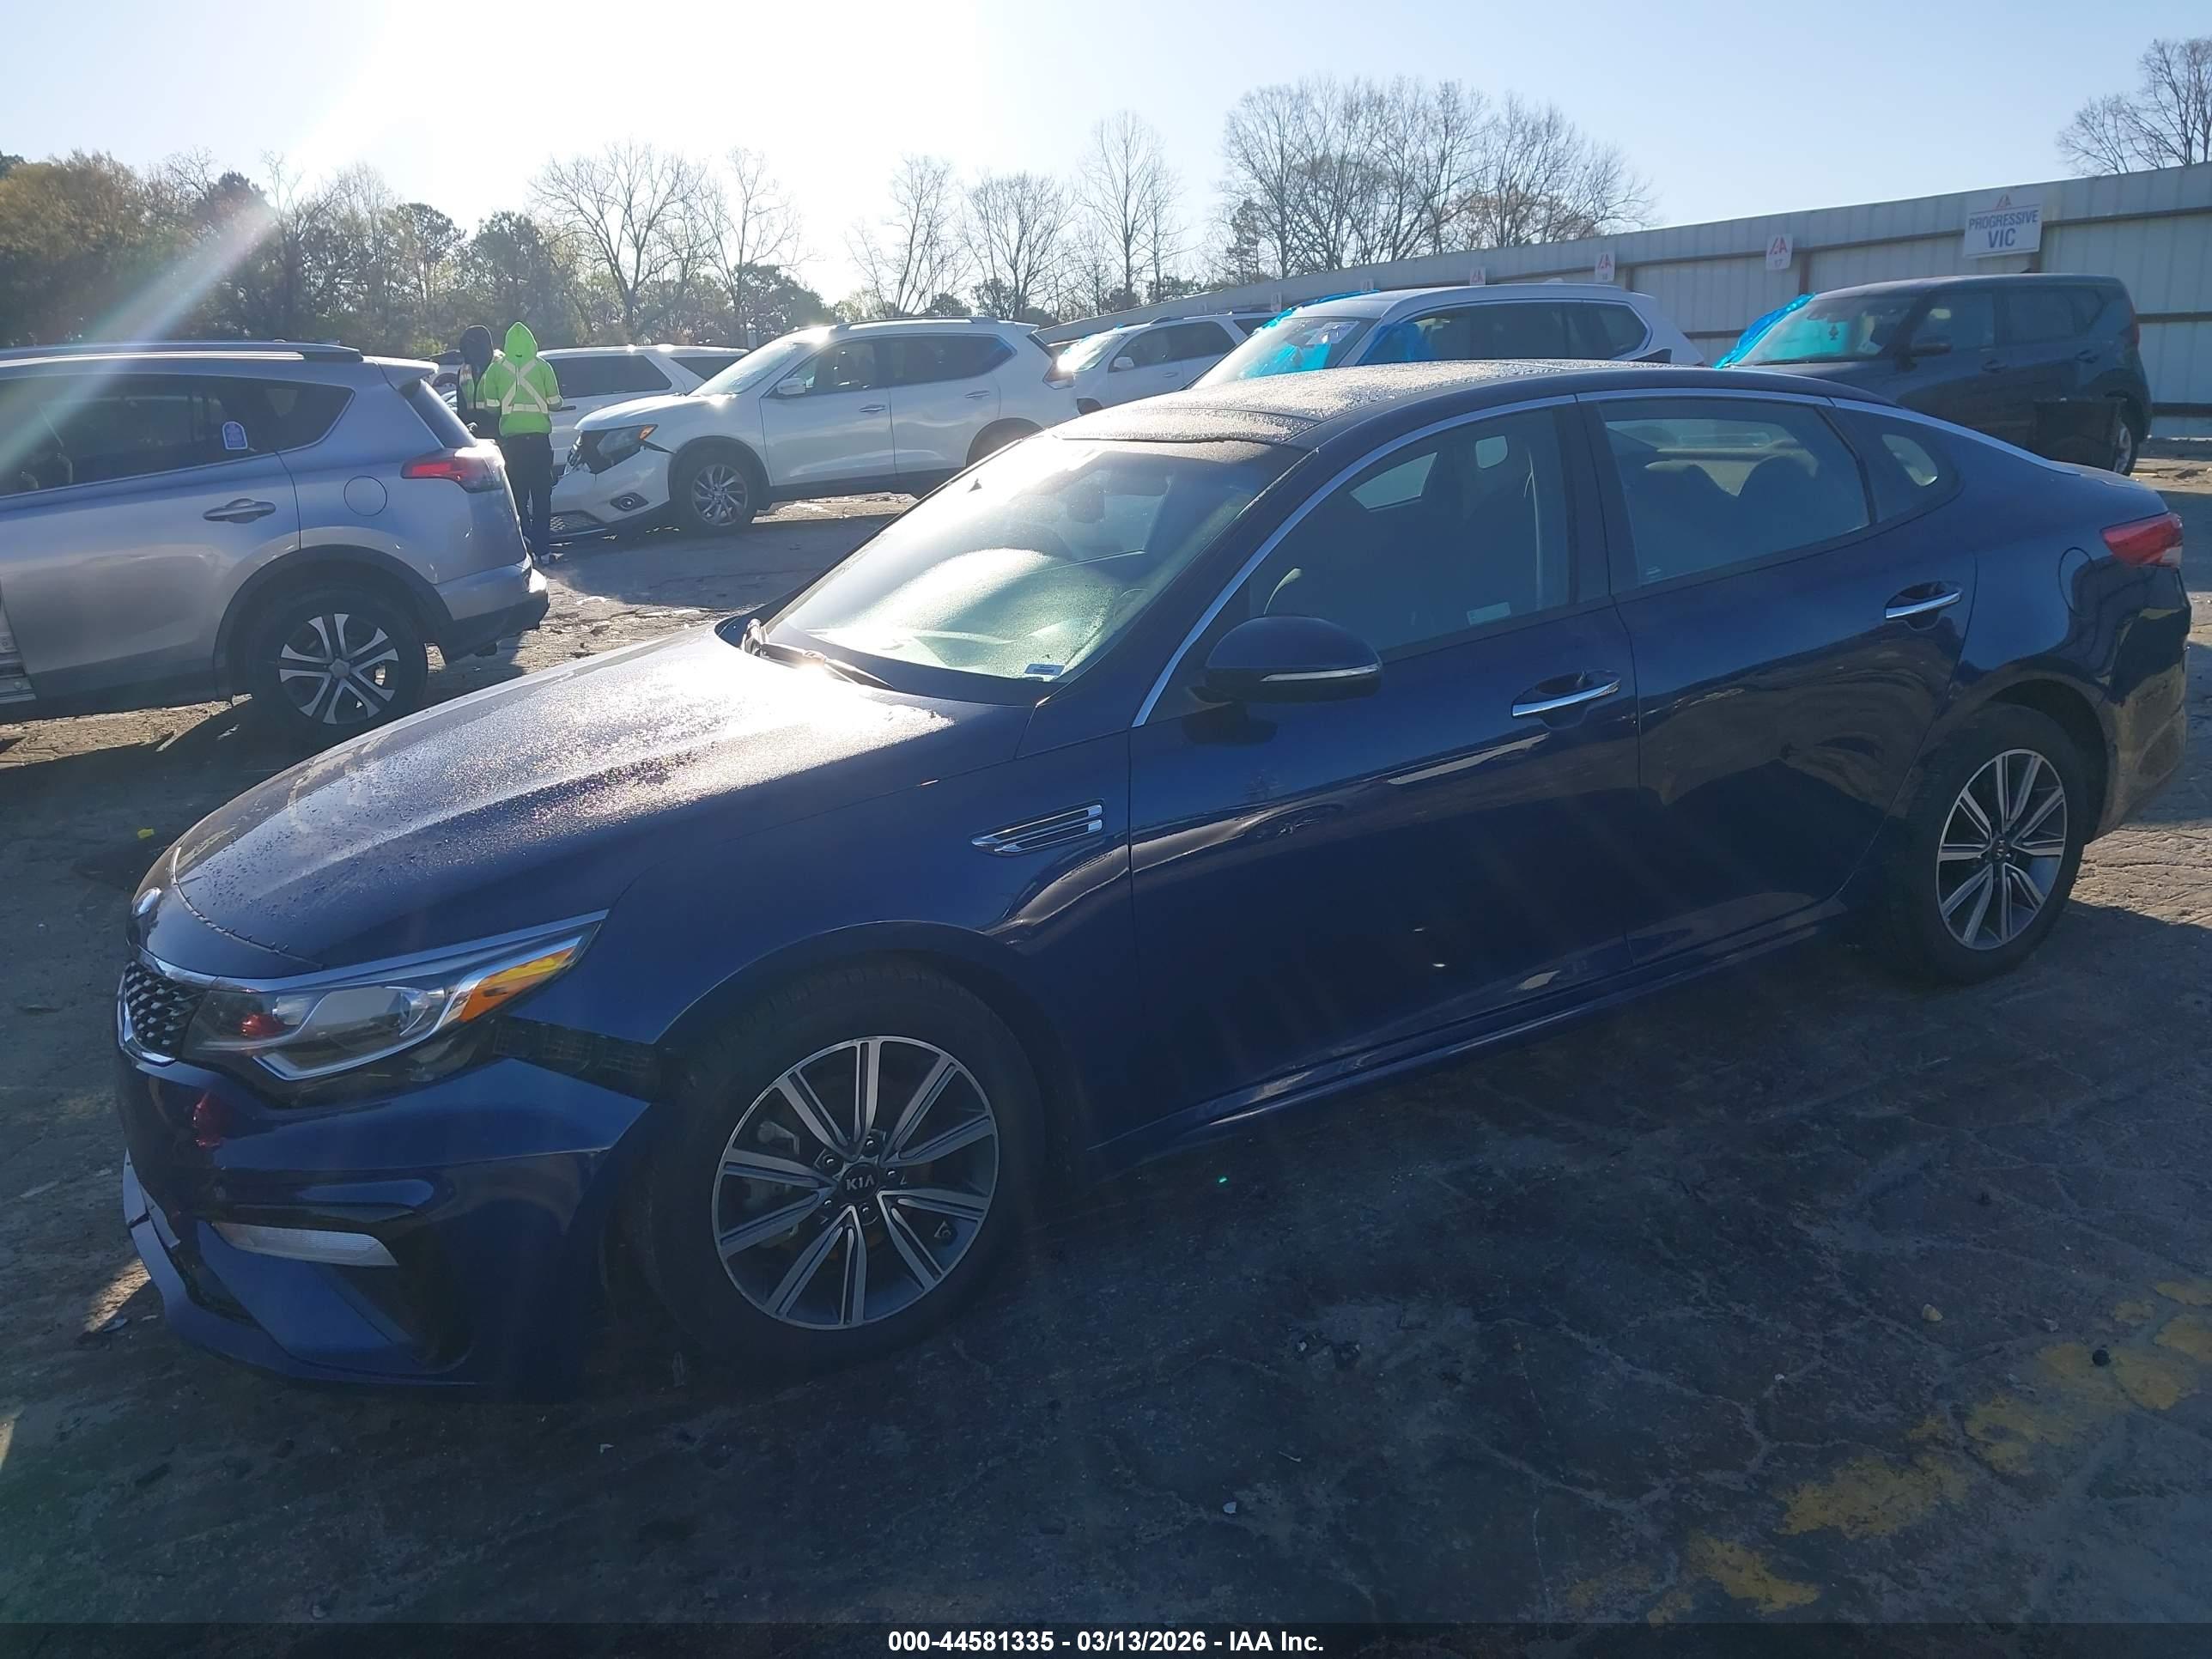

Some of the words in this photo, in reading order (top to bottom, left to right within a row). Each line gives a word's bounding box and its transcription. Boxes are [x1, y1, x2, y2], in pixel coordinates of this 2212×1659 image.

[1968, 210, 2039, 230] PROGRESSIVE
[1988, 228, 2016, 248] VIC
[846, 1174, 875, 1191] KIA
